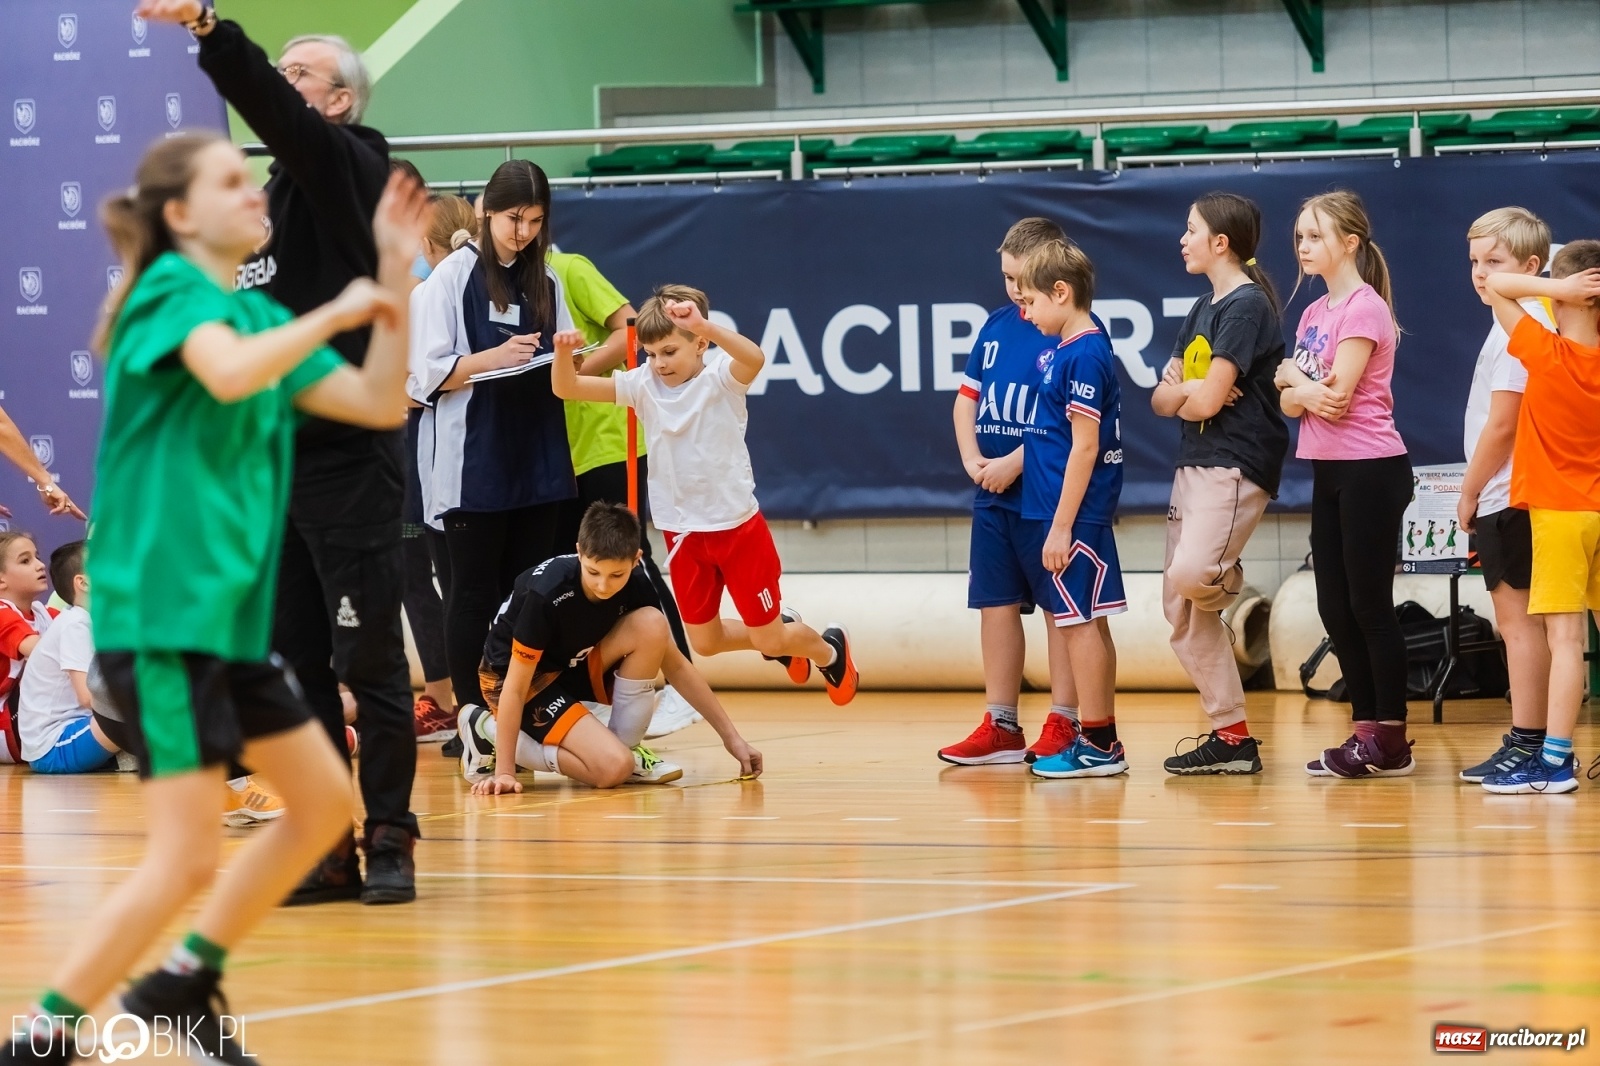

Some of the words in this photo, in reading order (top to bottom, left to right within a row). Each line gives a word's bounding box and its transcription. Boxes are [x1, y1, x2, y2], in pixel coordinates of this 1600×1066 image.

[982, 340, 999, 371] 10
[983, 424, 1000, 434] LIVE
[1002, 426, 1026, 438] LIMI
[757, 588, 774, 613] 10
[545, 696, 566, 718] JSW
